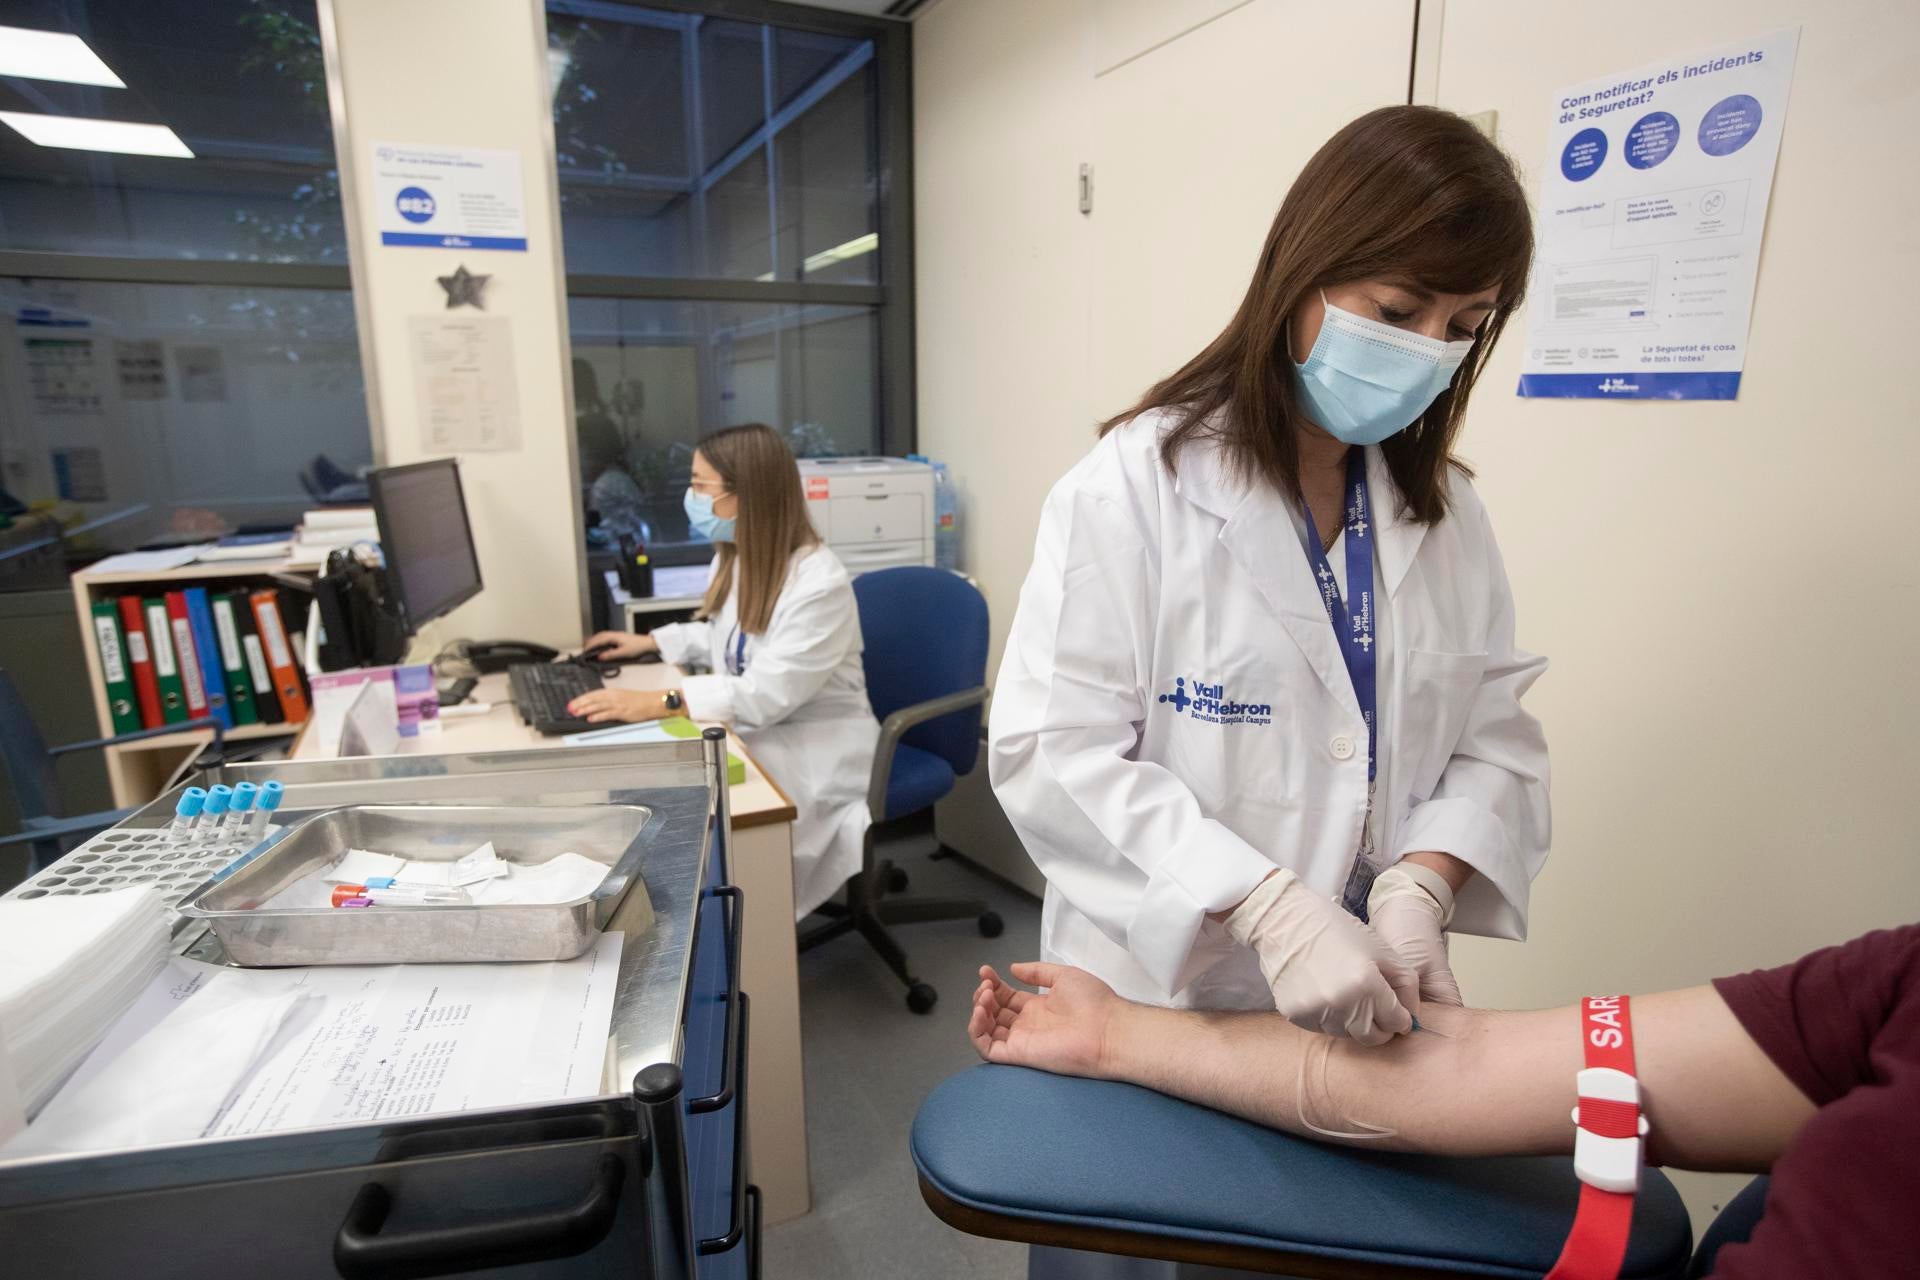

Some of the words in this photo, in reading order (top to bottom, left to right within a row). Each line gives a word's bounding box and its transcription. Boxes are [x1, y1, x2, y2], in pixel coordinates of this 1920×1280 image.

[1561, 95, 1596, 110] Com
[1594, 77, 1653, 100] notificar
[1657, 70, 1678, 85] els
[1683, 50, 1763, 76] incidents
[1559, 111, 1576, 124] de
[1578, 91, 1654, 120] Seguretat?
[1654, 344, 1698, 354] Seguretat
[1713, 344, 1736, 352] cosa
[1640, 355, 1652, 363] de
[1654, 355, 1671, 363] tots
[1678, 354, 1705, 363] totes!
[1330, 582, 1339, 598] Vall
[1353, 615, 1362, 632] Vall
[1193, 681, 1223, 699] Vall
[1192, 698, 1271, 715] d'Hebron
[1191, 711, 1219, 723] Barcelona
[1220, 716, 1245, 725] Hospital
[1246, 716, 1271, 726] Campus
